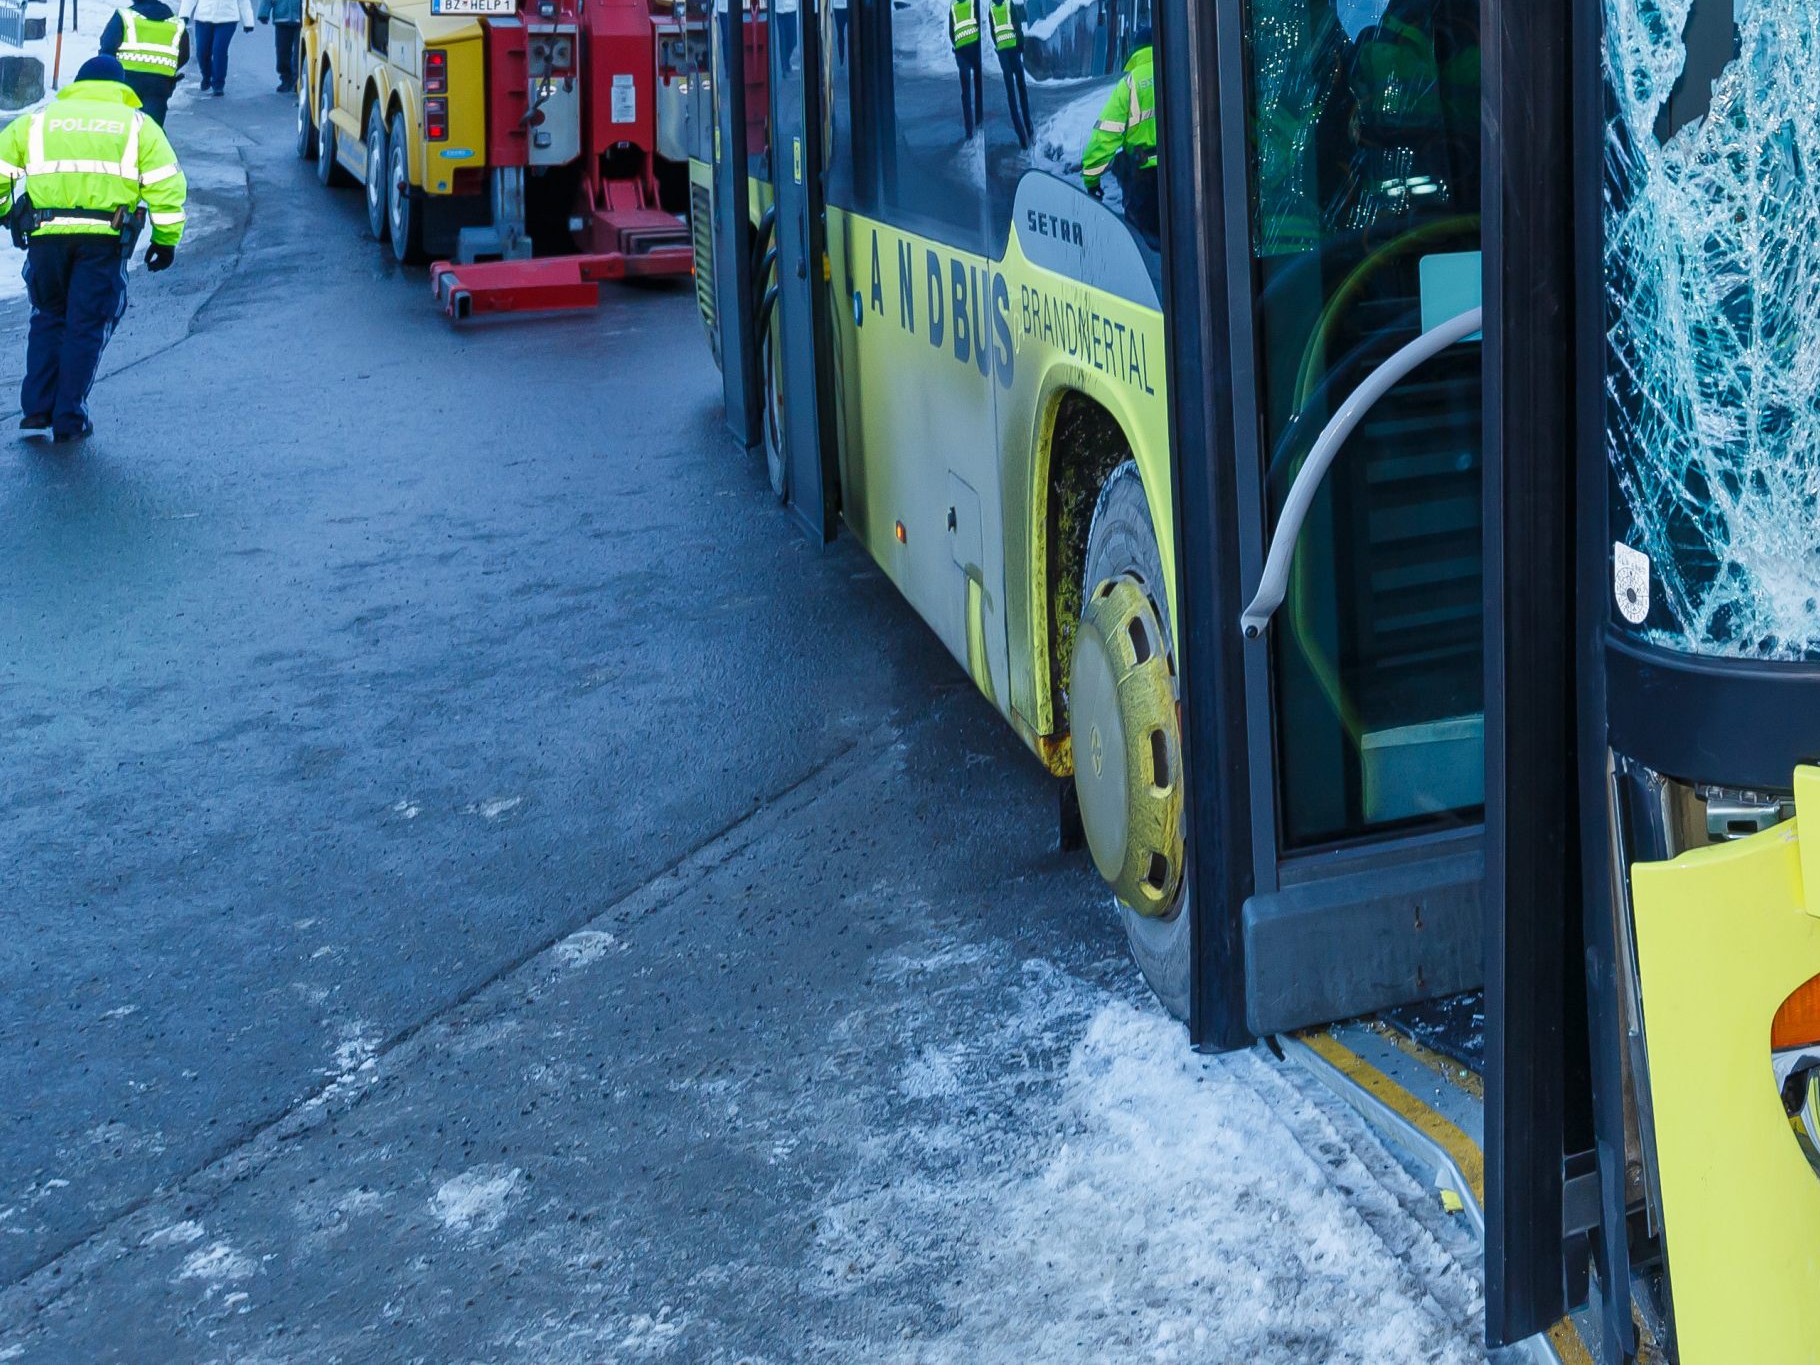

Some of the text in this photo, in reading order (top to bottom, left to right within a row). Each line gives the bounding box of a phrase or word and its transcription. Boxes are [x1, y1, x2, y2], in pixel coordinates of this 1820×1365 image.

[445, 0, 461, 10] BZ
[470, 0, 501, 10] HELP
[48, 118, 125, 135] POLIZEI
[1027, 208, 1084, 247] SETRA
[1021, 284, 1155, 395] BRANDNERTAL
